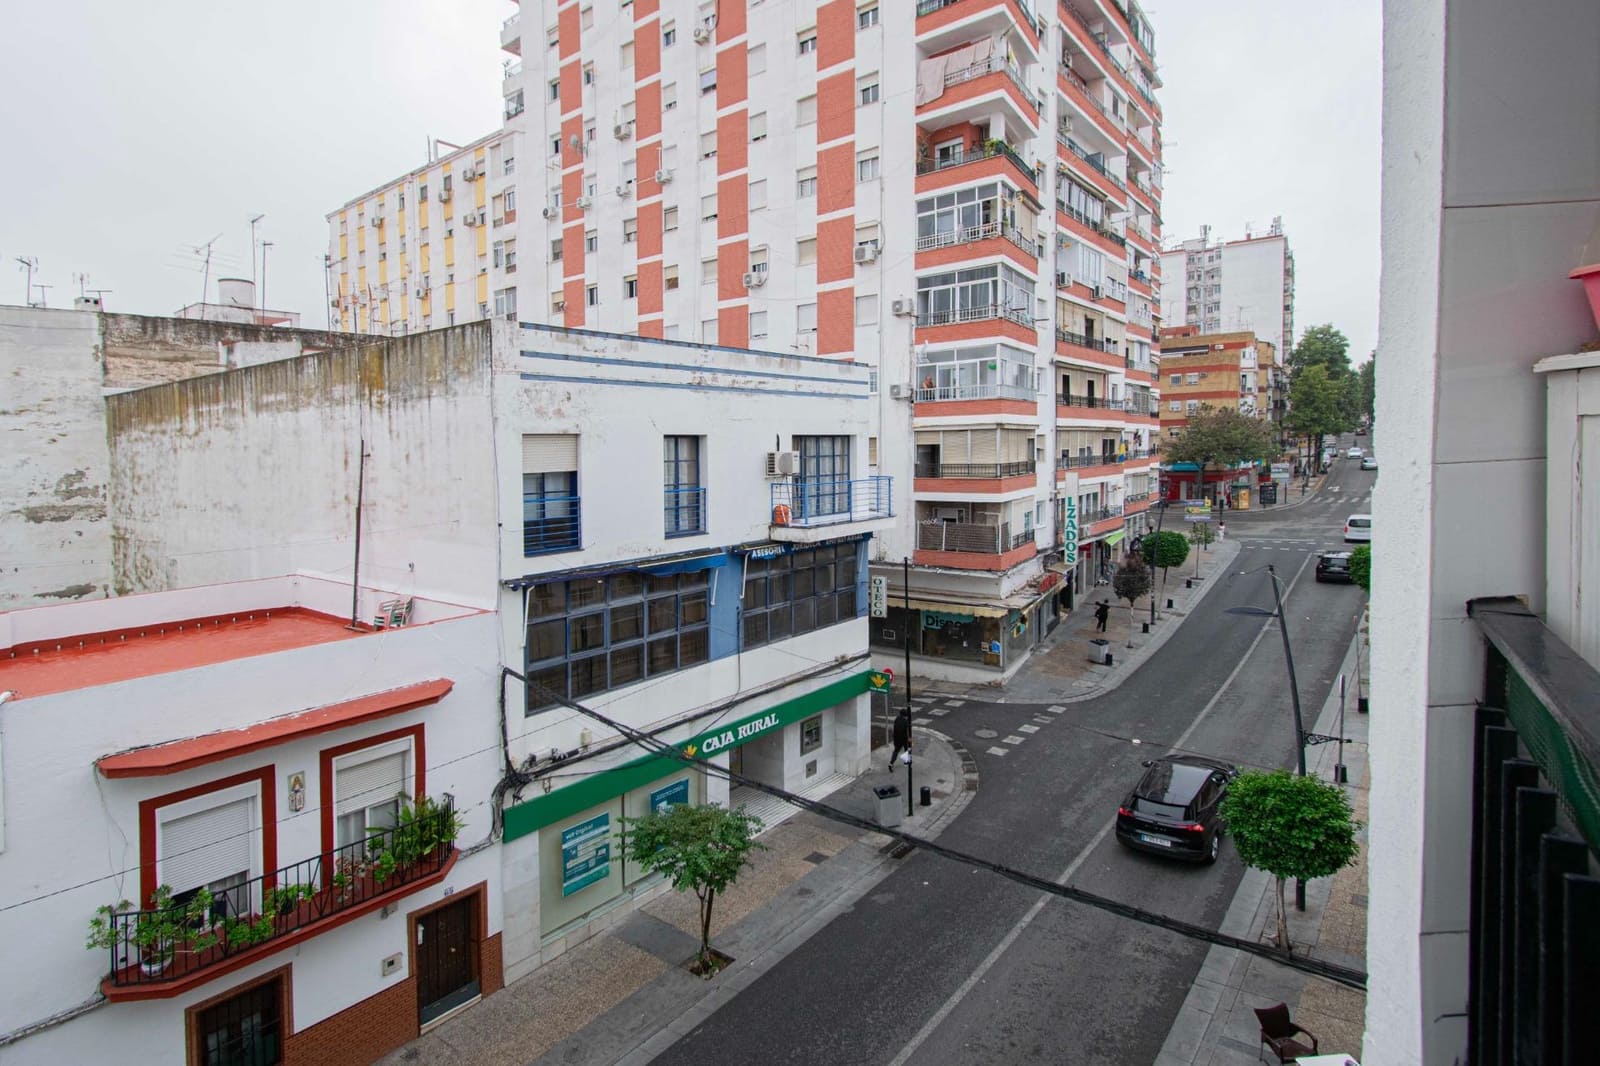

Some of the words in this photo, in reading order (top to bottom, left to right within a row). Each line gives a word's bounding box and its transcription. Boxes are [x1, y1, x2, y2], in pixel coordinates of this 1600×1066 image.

[1065, 496, 1077, 564] LZADOS
[873, 578, 882, 617] OTECO
[702, 731, 735, 753] CAJA
[737, 713, 779, 739] RURAL
